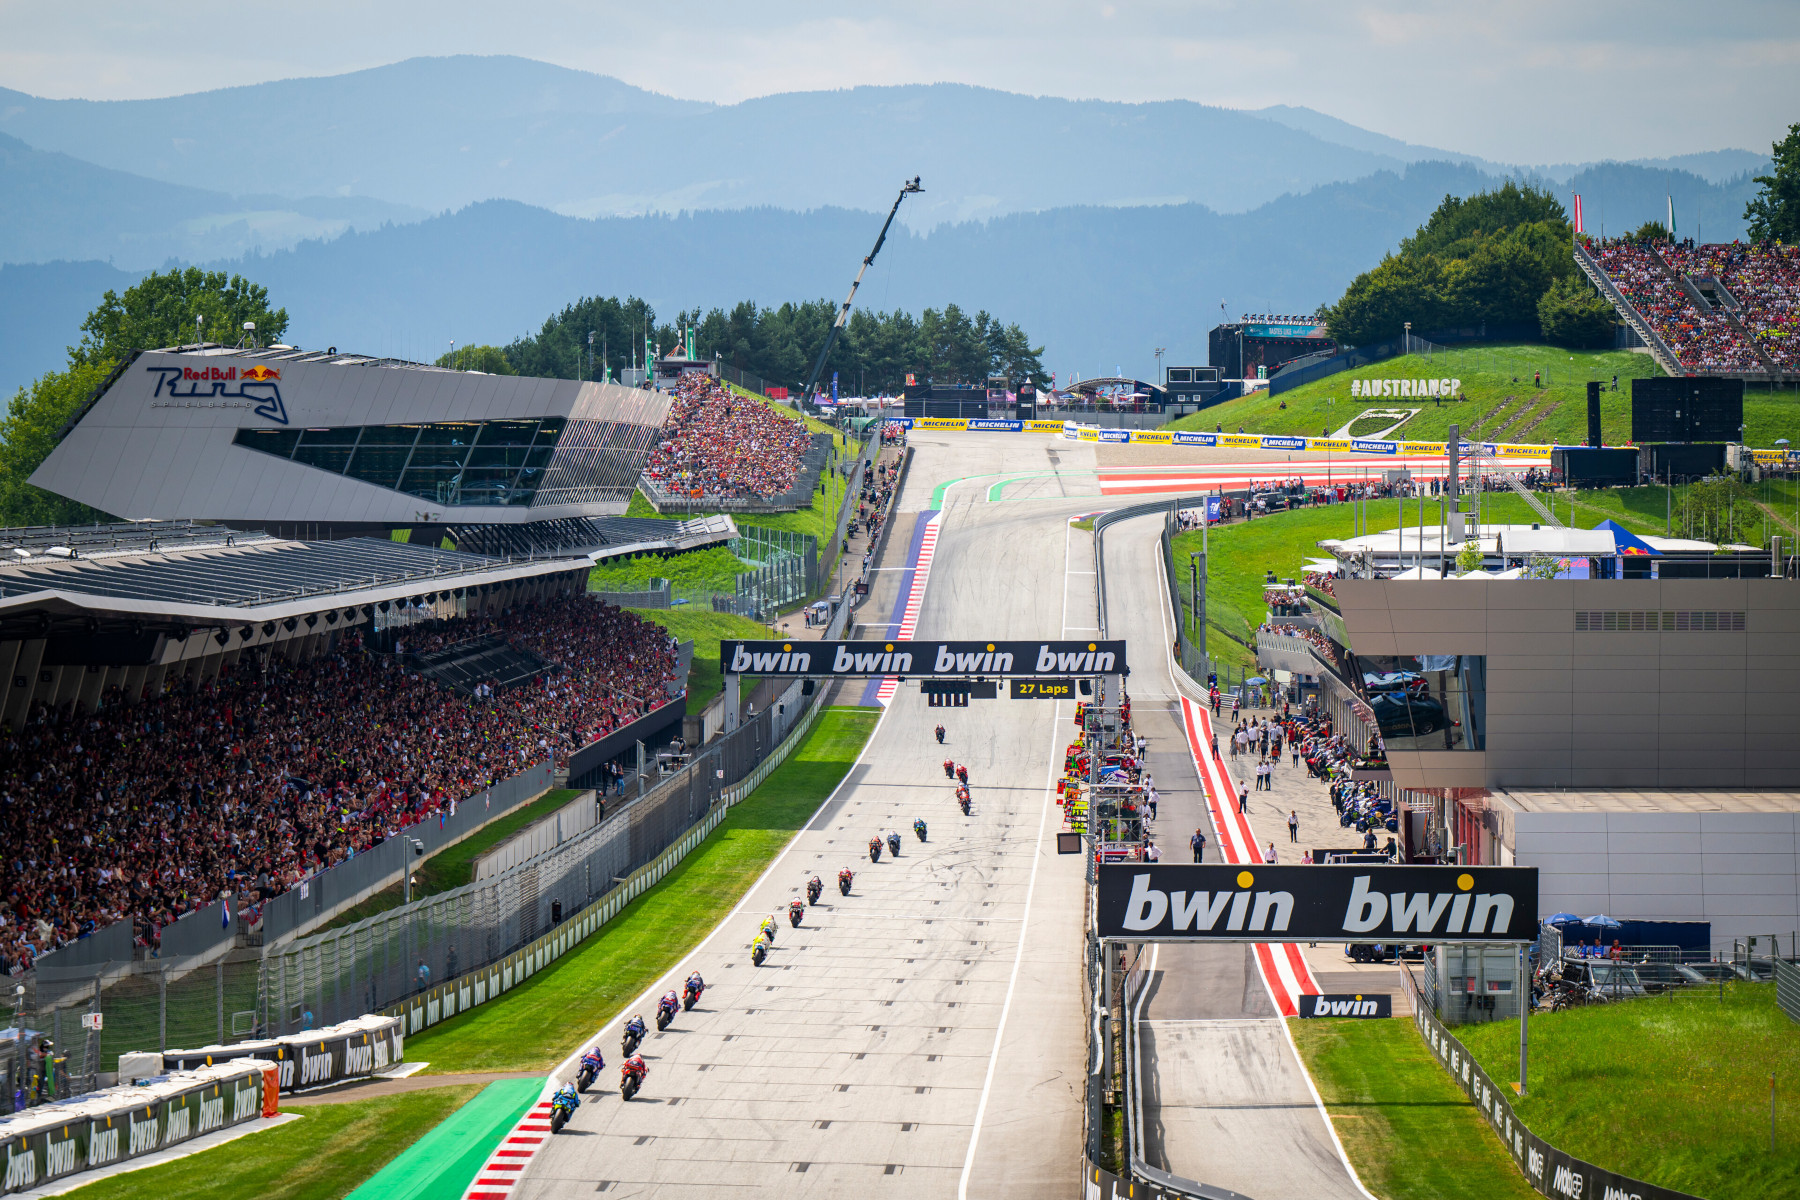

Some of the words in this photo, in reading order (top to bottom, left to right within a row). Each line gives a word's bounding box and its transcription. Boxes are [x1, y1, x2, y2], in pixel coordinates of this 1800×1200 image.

[184, 367, 209, 380] Red
[211, 367, 236, 380] Bull
[1351, 379, 1461, 397] #AUSTRIANGP
[1268, 439, 1303, 447] MICHELIN
[1358, 442, 1395, 451] MICHELIN
[730, 643, 811, 672] bwin
[832, 643, 913, 672] bwin
[934, 643, 1014, 672] bwin
[1035, 643, 1116, 672] bwin
[1019, 684, 1035, 693] 27
[1039, 684, 1069, 696] Laps
[1122, 871, 1295, 931] bwin
[1342, 873, 1515, 933] bwin
[1313, 994, 1378, 1016] bwin
[301, 1041, 332, 1085] bwin
[345, 1033, 372, 1075] bwin
[198, 1084, 224, 1132] bwin
[234, 1074, 257, 1121] bwin
[129, 1105, 159, 1155] bwin
[166, 1094, 190, 1144] bwin
[46, 1125, 76, 1177] bwin
[89, 1115, 119, 1166] bwin
[5, 1136, 36, 1190] bwin
[1553, 1164, 1583, 1200] MotoGP
